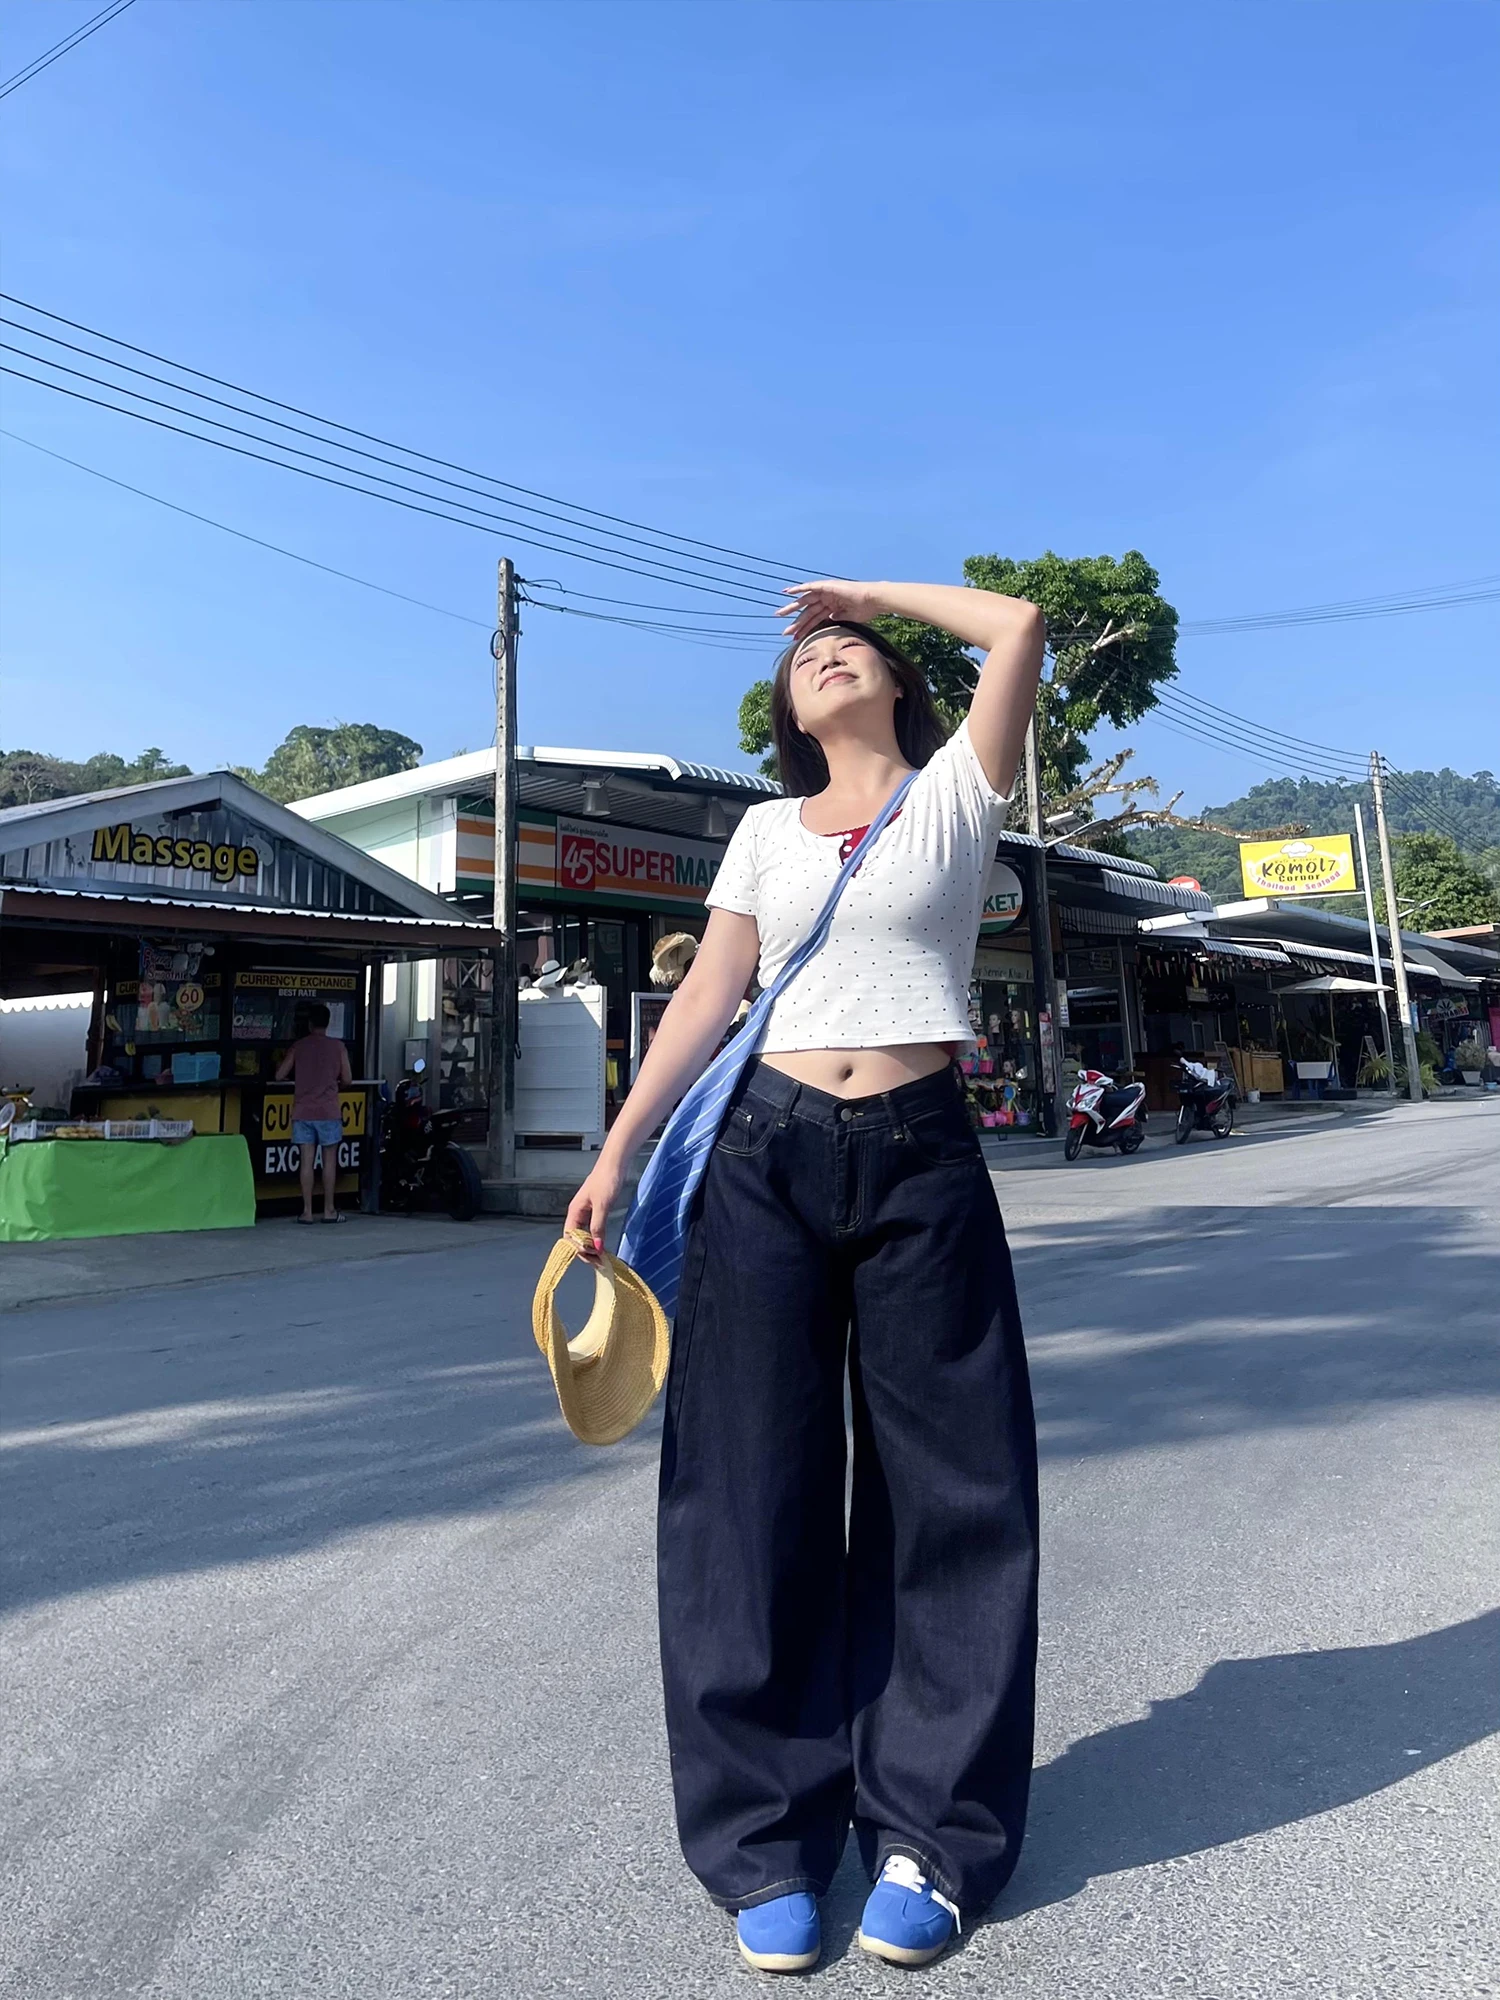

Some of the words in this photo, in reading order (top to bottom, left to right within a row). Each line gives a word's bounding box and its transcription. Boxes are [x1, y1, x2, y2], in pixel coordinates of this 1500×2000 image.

[91, 823, 259, 883] Massage
[563, 840, 594, 885] 45
[239, 974, 298, 986] CURRENCY
[300, 976, 354, 988] EXCHANGE
[278, 988, 297, 997] BEST
[298, 988, 317, 997] RATE
[179, 989, 200, 1004] 60
[265, 1142, 360, 1174] EXCAGE
